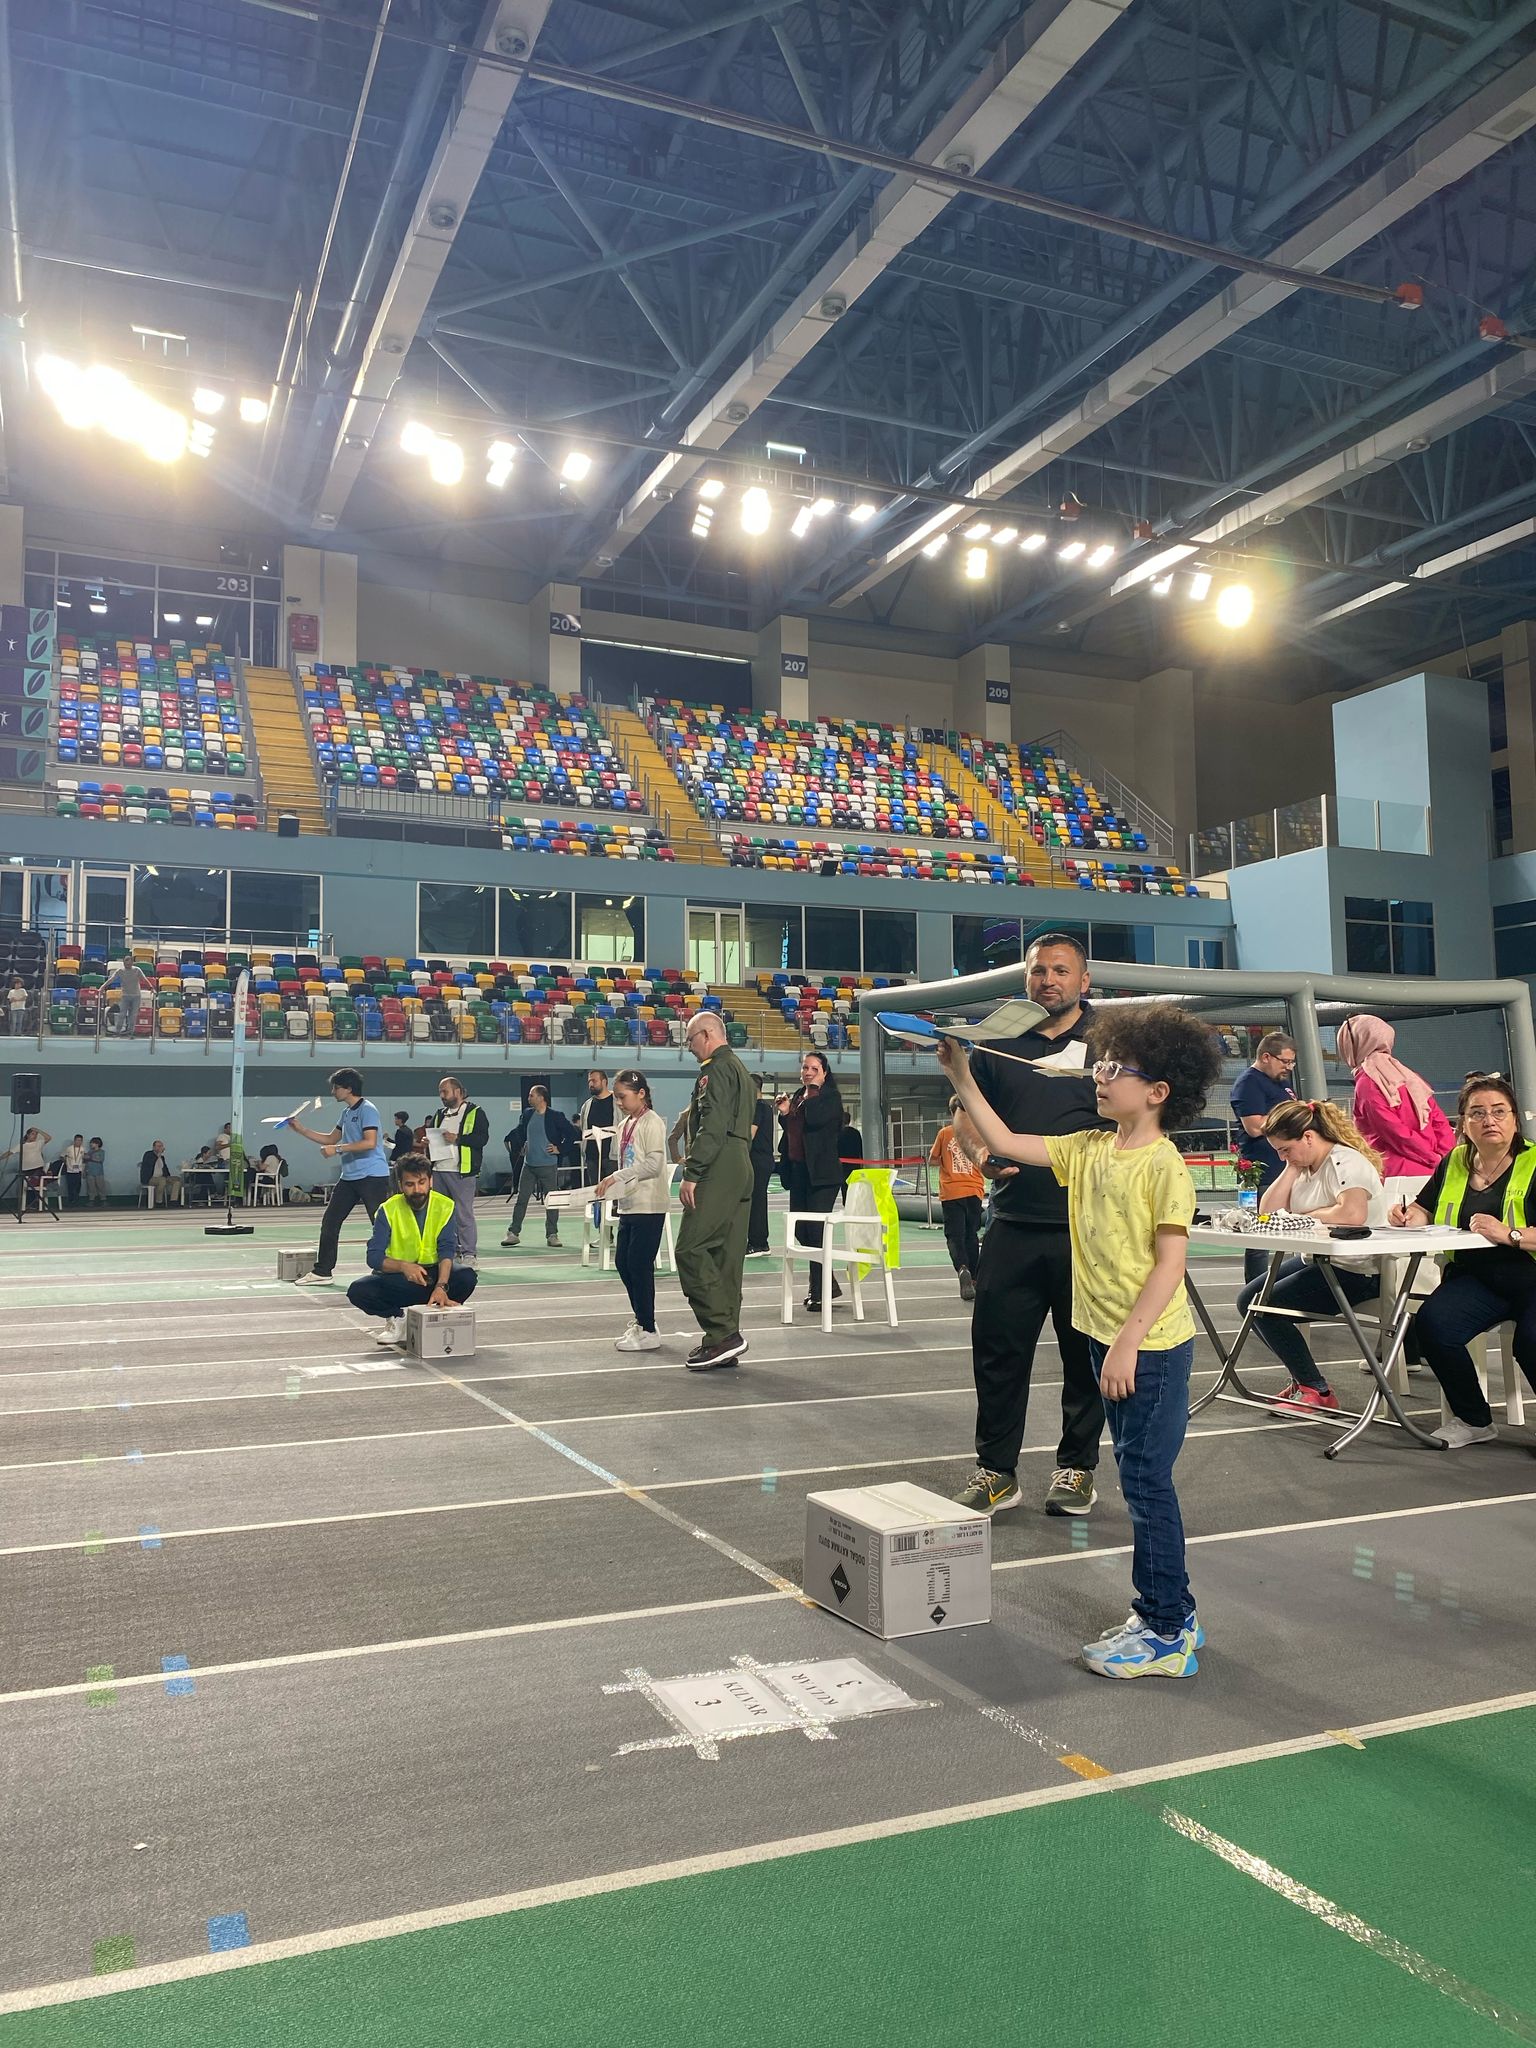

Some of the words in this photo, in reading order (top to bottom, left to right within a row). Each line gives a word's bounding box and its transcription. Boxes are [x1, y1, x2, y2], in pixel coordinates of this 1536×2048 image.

[216, 576, 249, 593] 203
[784, 660, 806, 672] 207
[988, 687, 1009, 698] 209
[830, 1541, 849, 1557] KAYNAK
[849, 1550, 866, 1566] DOĞAL
[867, 1534, 881, 1629] ULUDAĞ
[791, 1672, 839, 1706] KULVAR
[836, 1679, 863, 1690] 3
[694, 1697, 722, 1708] 3
[723, 1680, 768, 1717] KULVAR
